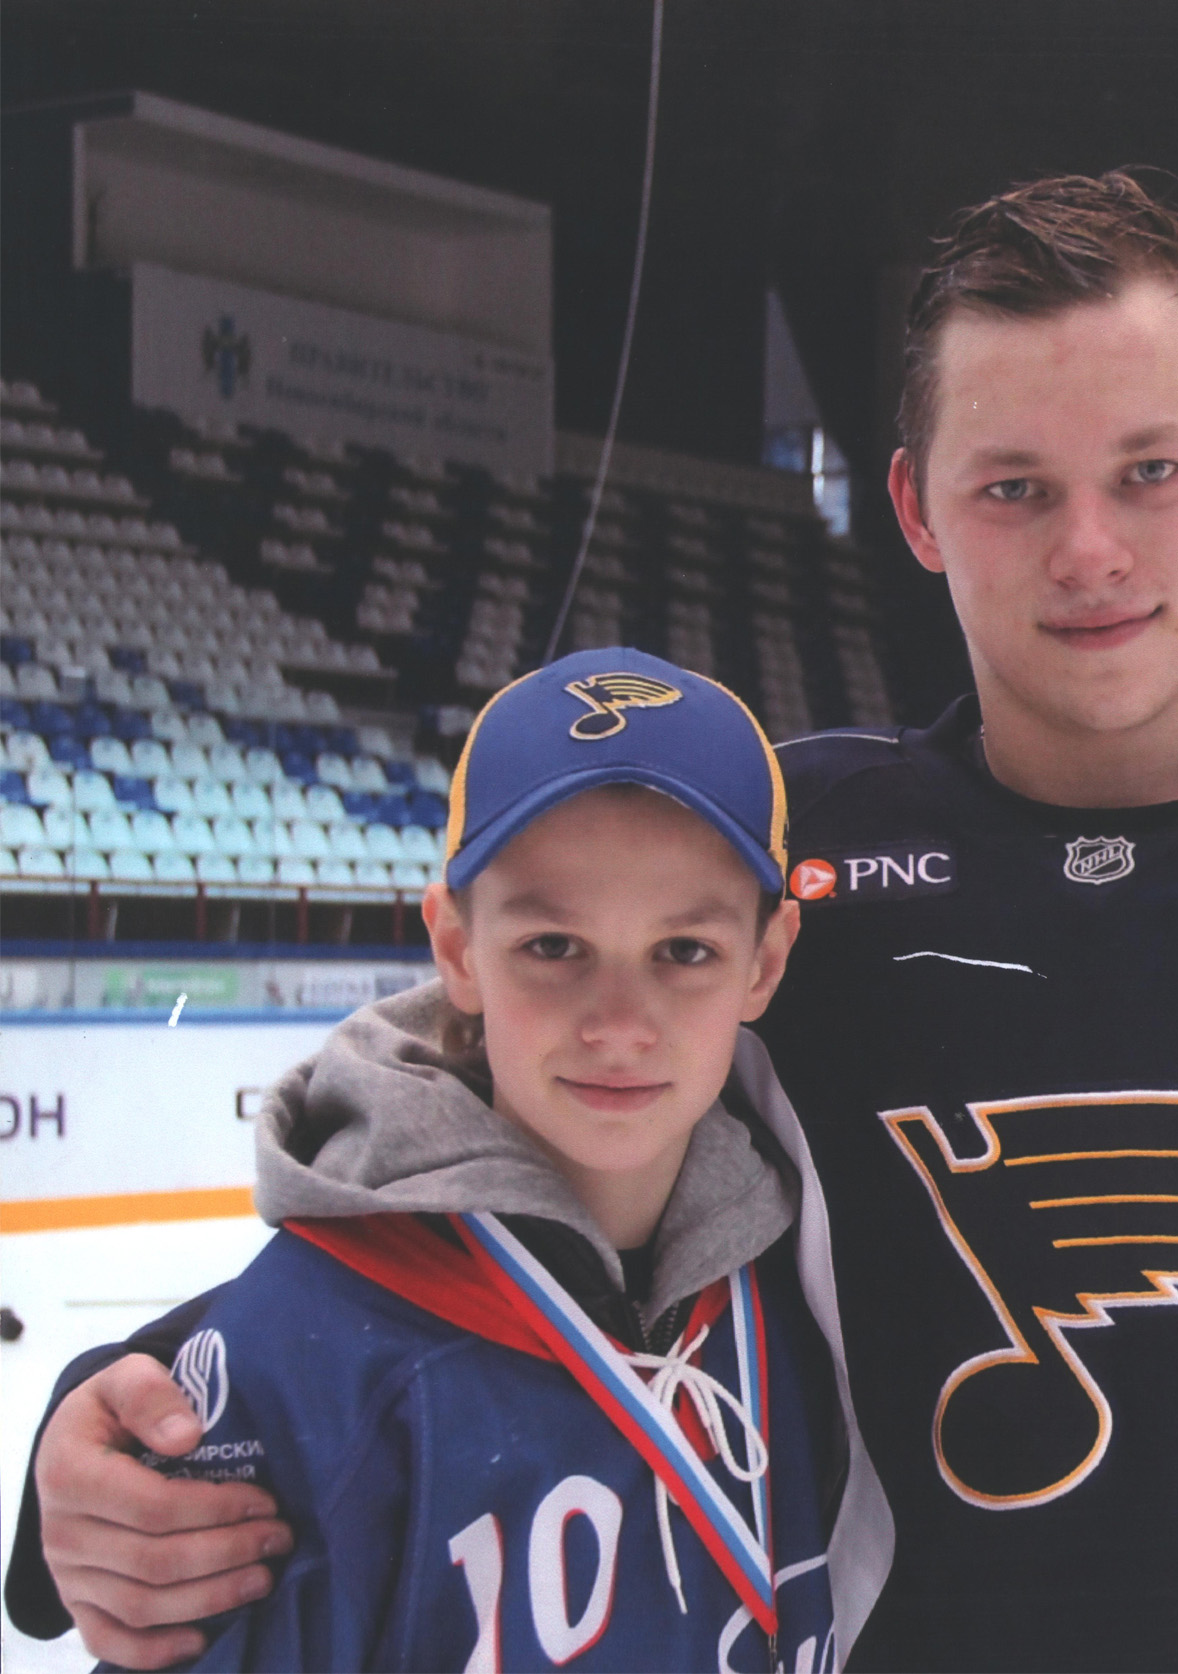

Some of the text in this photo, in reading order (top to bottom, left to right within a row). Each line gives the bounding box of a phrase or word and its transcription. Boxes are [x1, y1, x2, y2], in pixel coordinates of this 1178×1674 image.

[843, 852, 952, 891] PNC
[1076, 845, 1121, 876] NHL
[447, 1474, 624, 1674] 10
